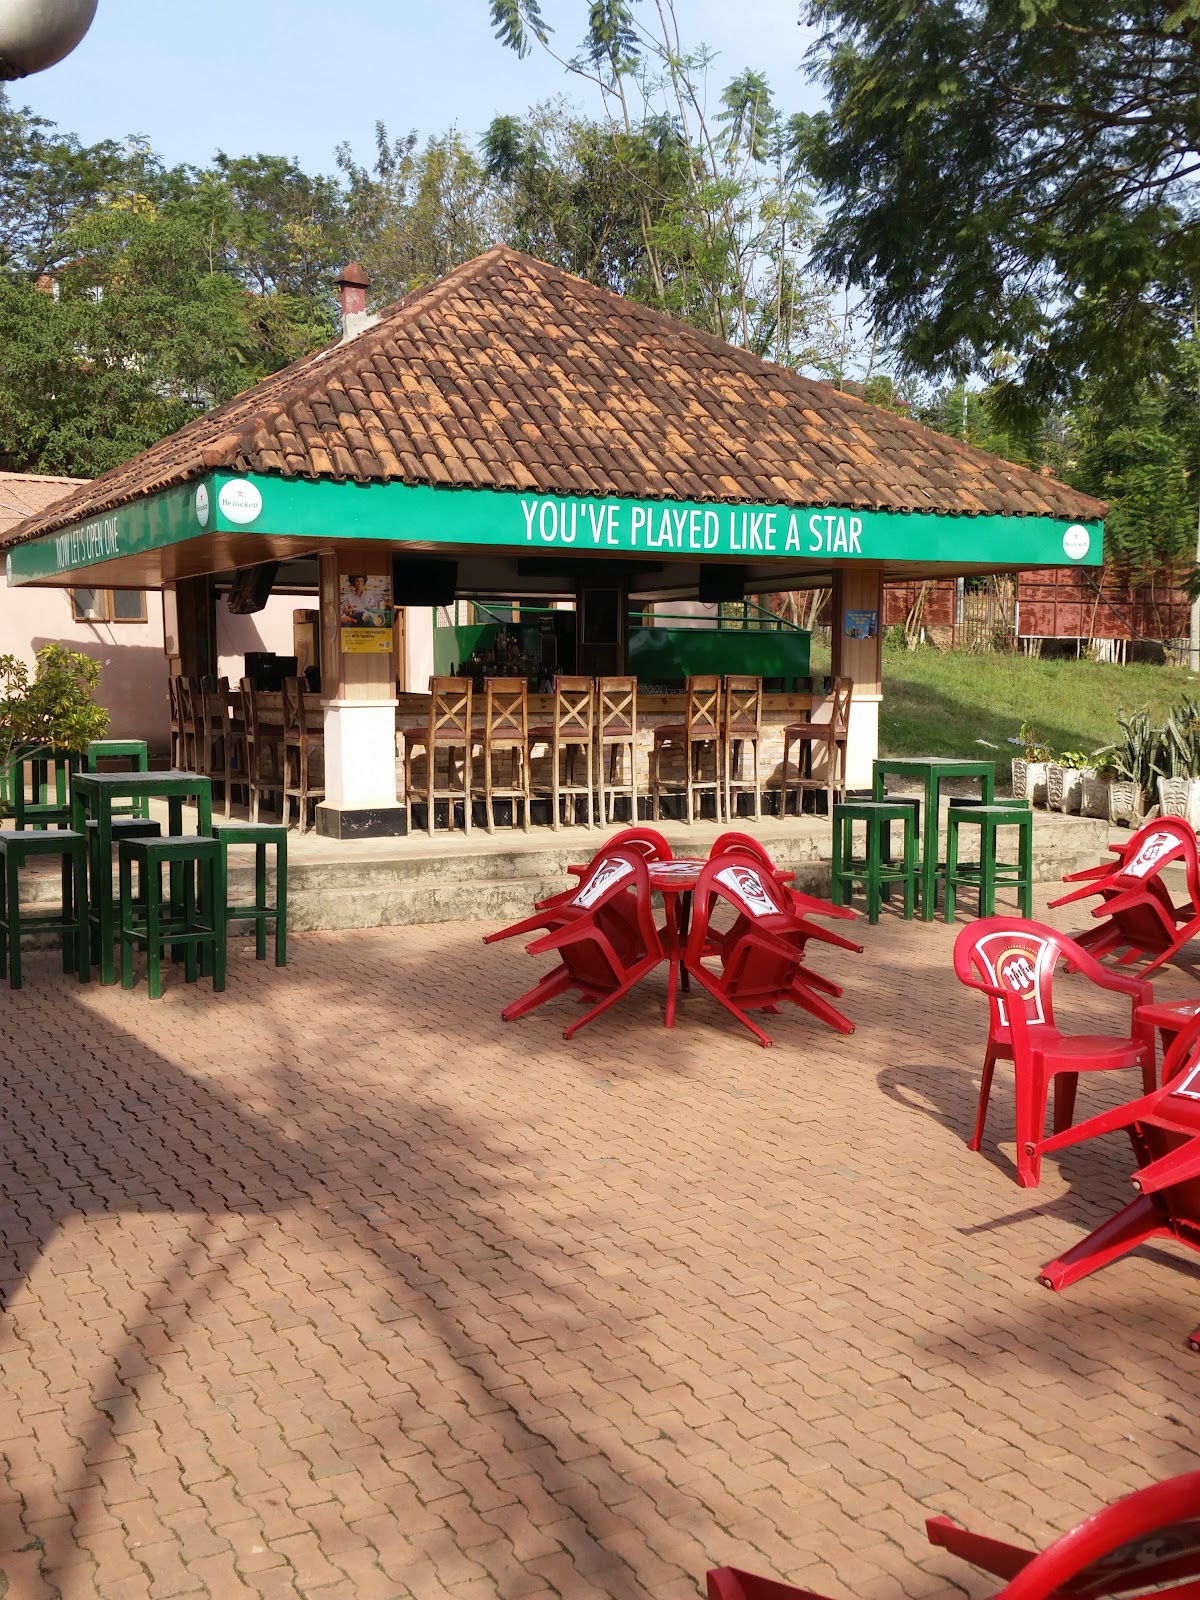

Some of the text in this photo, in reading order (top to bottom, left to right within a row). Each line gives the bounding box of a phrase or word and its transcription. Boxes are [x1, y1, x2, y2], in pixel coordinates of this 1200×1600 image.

[222, 498, 259, 508] Heineken
[520, 499, 864, 554] YOU'VE PLAYED LIKE A STAR
[56, 517, 120, 569] NOW LET'S OPEN ONE
